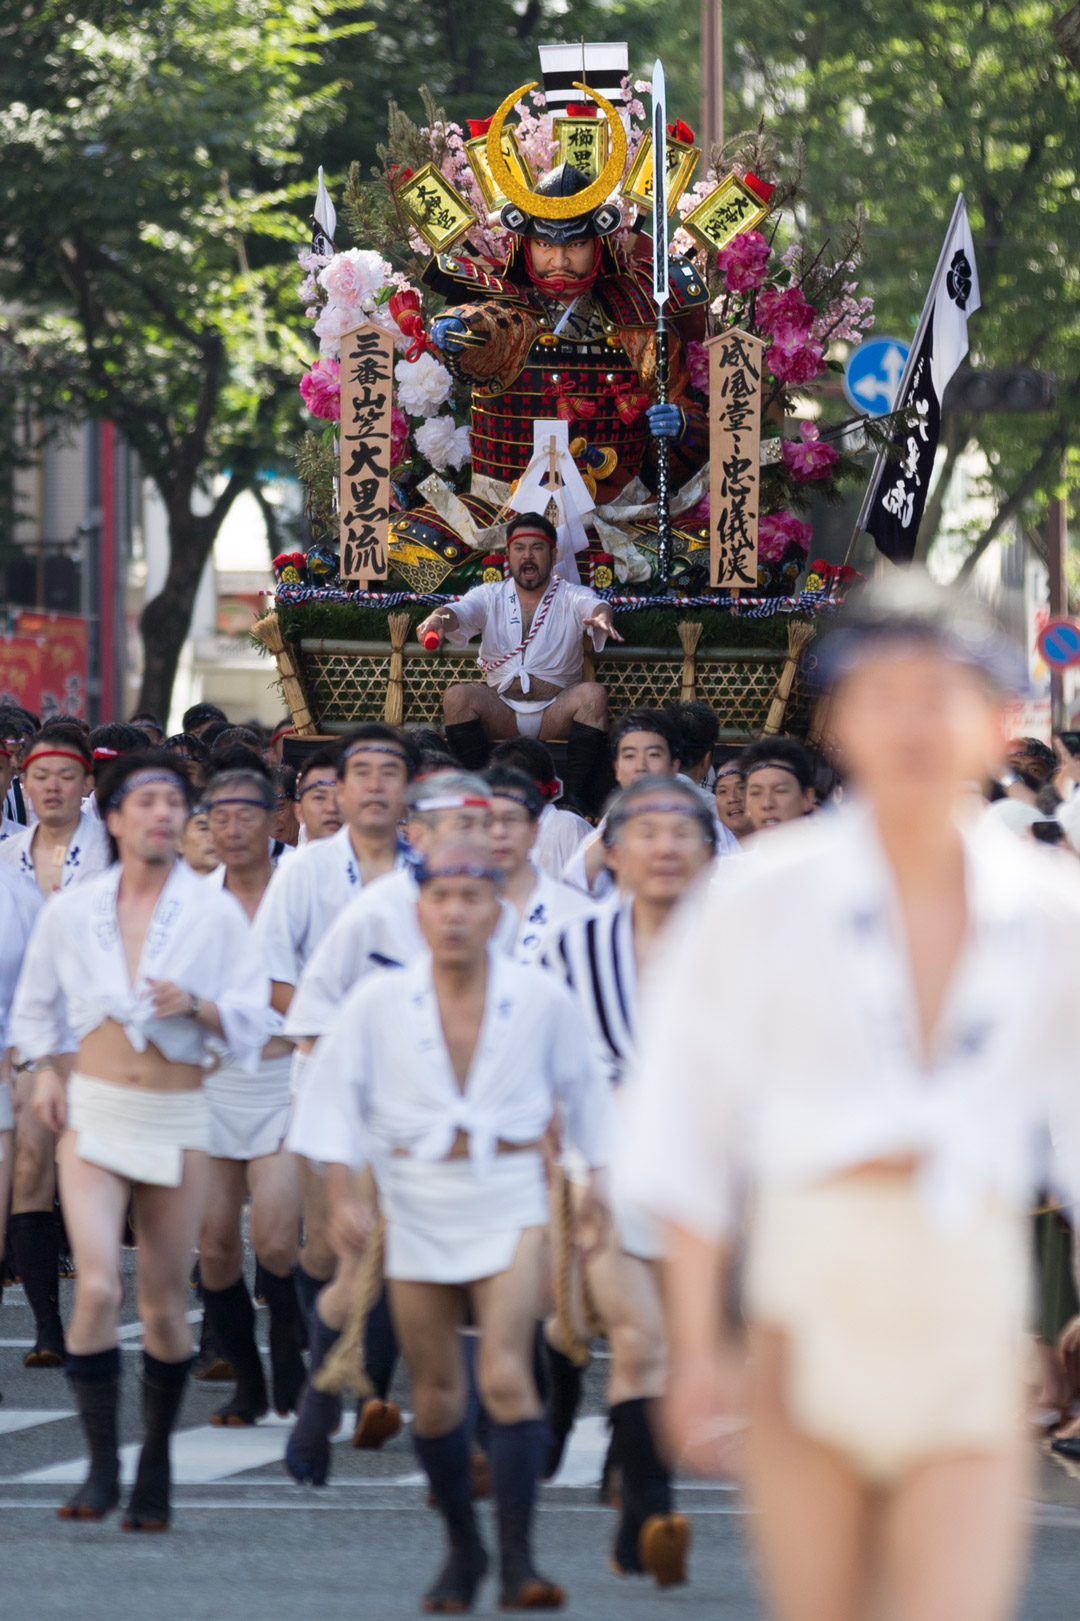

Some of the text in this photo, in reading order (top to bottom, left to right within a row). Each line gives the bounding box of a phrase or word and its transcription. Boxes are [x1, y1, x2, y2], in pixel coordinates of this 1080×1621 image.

[416, 185, 457, 230] 大神宮
[704, 196, 749, 240] 大神宮
[343, 331, 391, 576] 三番山笠大黒流
